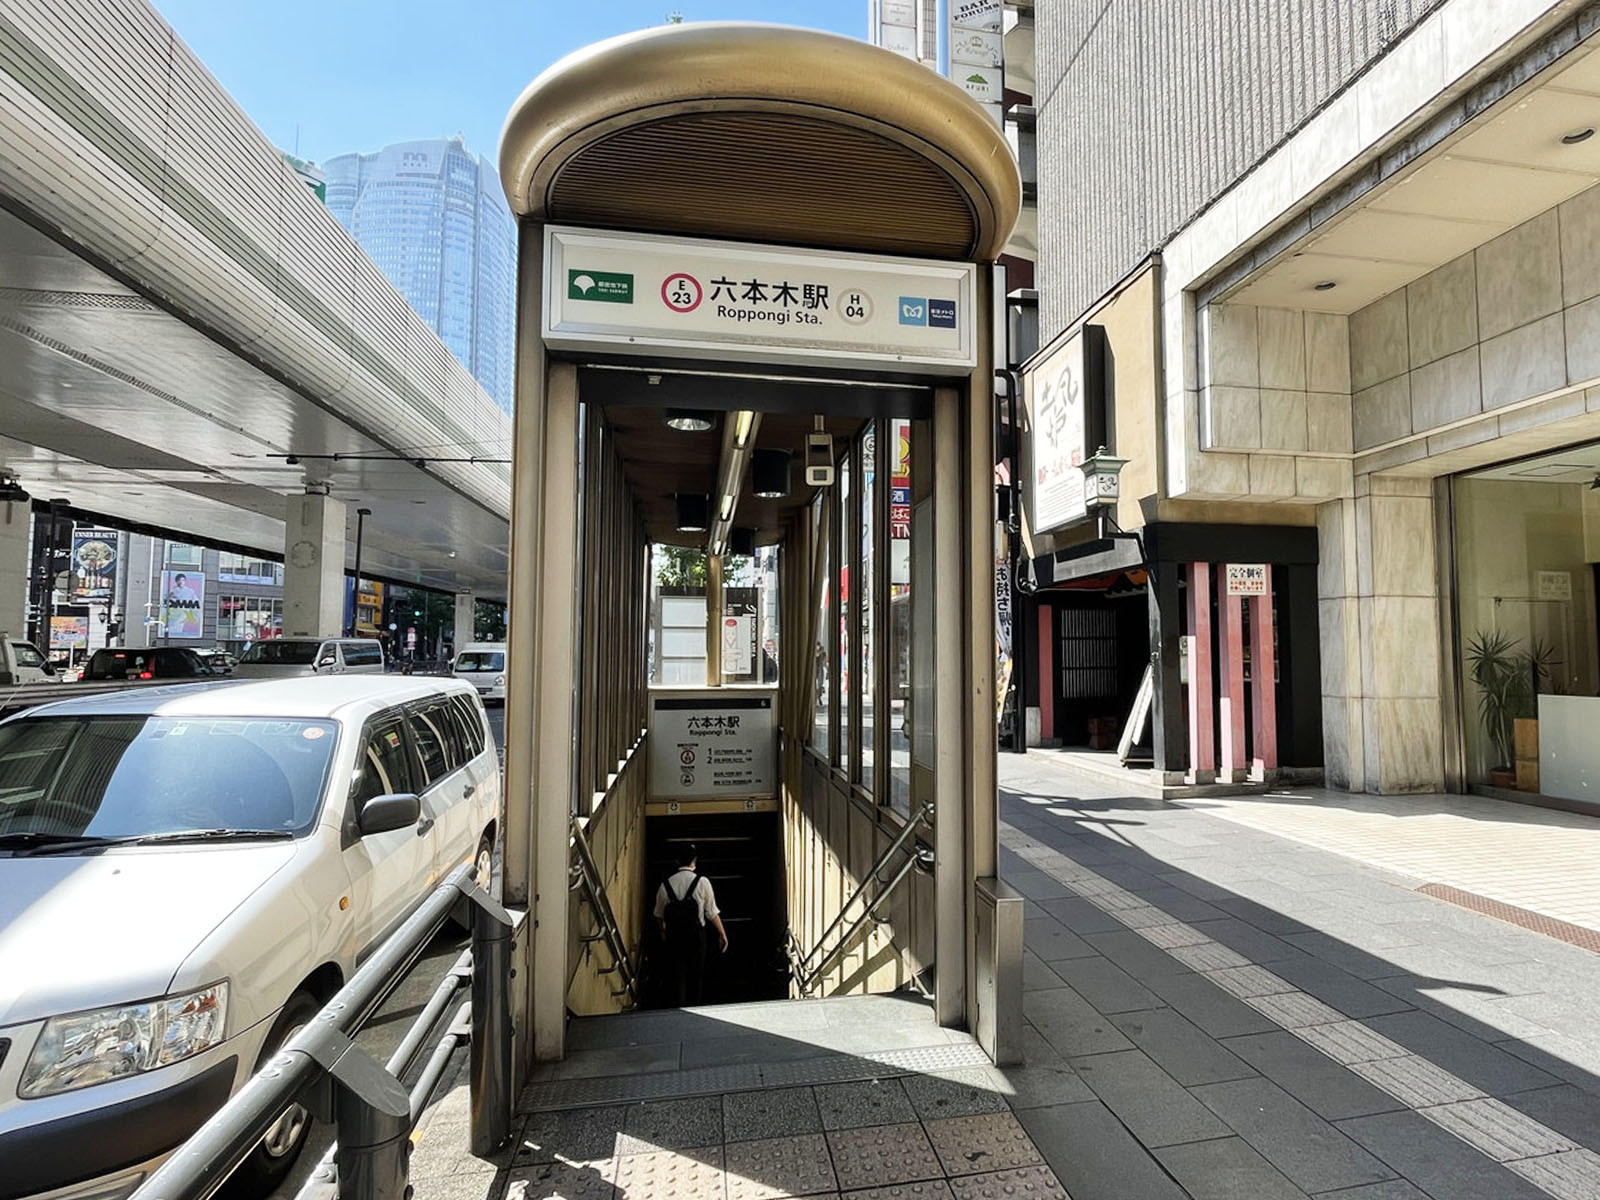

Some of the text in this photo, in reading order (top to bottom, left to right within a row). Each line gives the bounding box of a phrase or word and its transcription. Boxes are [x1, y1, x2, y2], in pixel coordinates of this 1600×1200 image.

[679, 280, 686, 290] E
[672, 292, 692, 304] 23
[710, 276, 829, 310] 六本木駅
[850, 294, 860, 305] H
[717, 305, 823, 325] Roppongi Sta.
[846, 306, 864, 318] 04
[687, 716, 740, 728] 六本木駅
